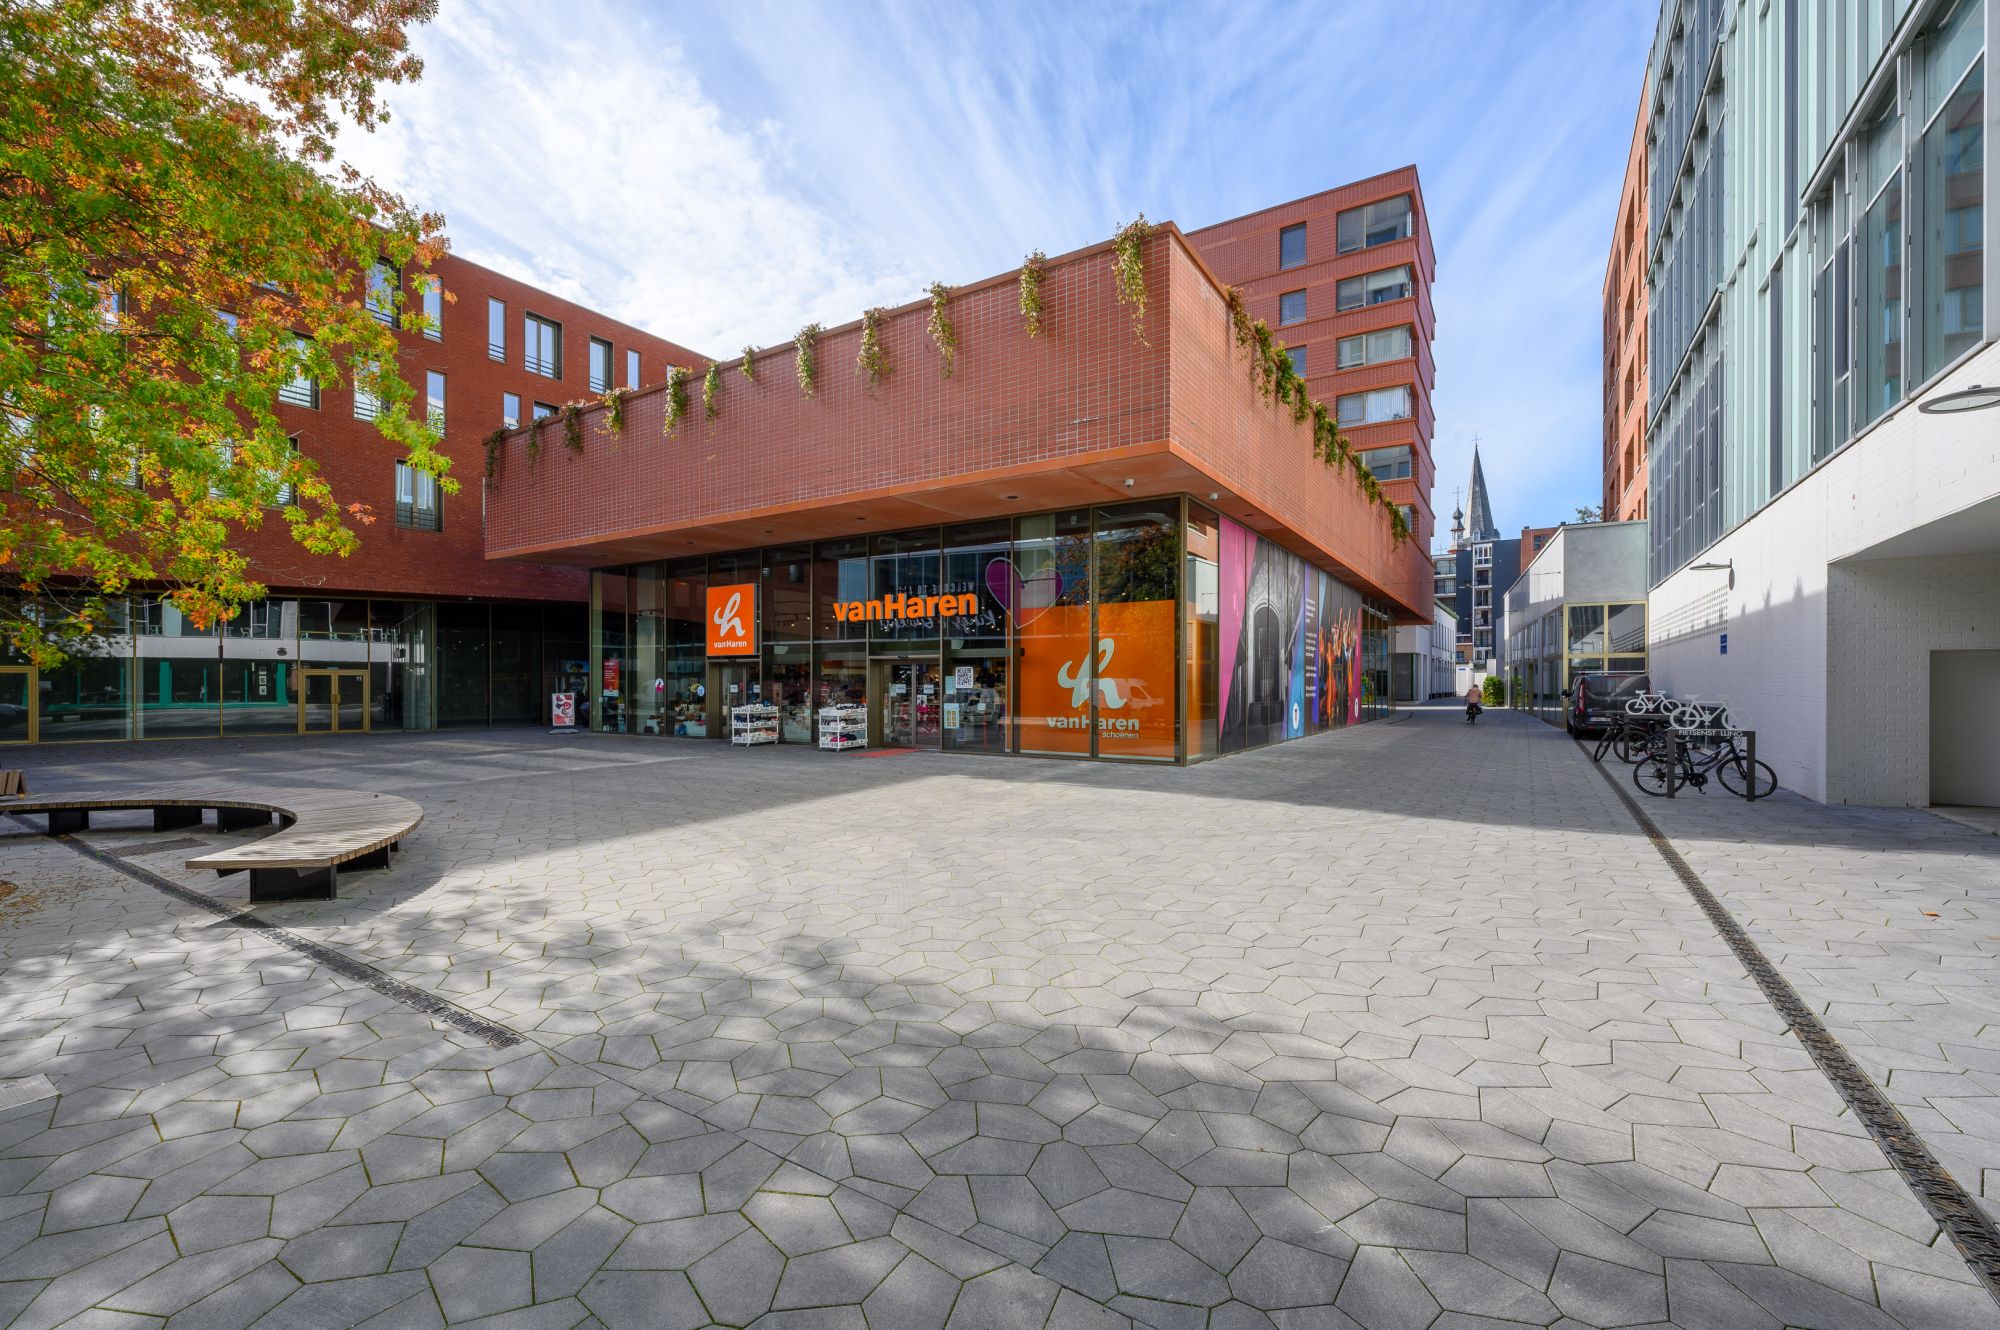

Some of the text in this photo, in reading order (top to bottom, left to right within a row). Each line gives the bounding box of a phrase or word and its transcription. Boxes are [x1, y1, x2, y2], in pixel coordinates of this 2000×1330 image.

[833, 592, 978, 622] vanHaren
[713, 640, 747, 648] vanHaren
[1102, 731, 1139, 739] schoenen
